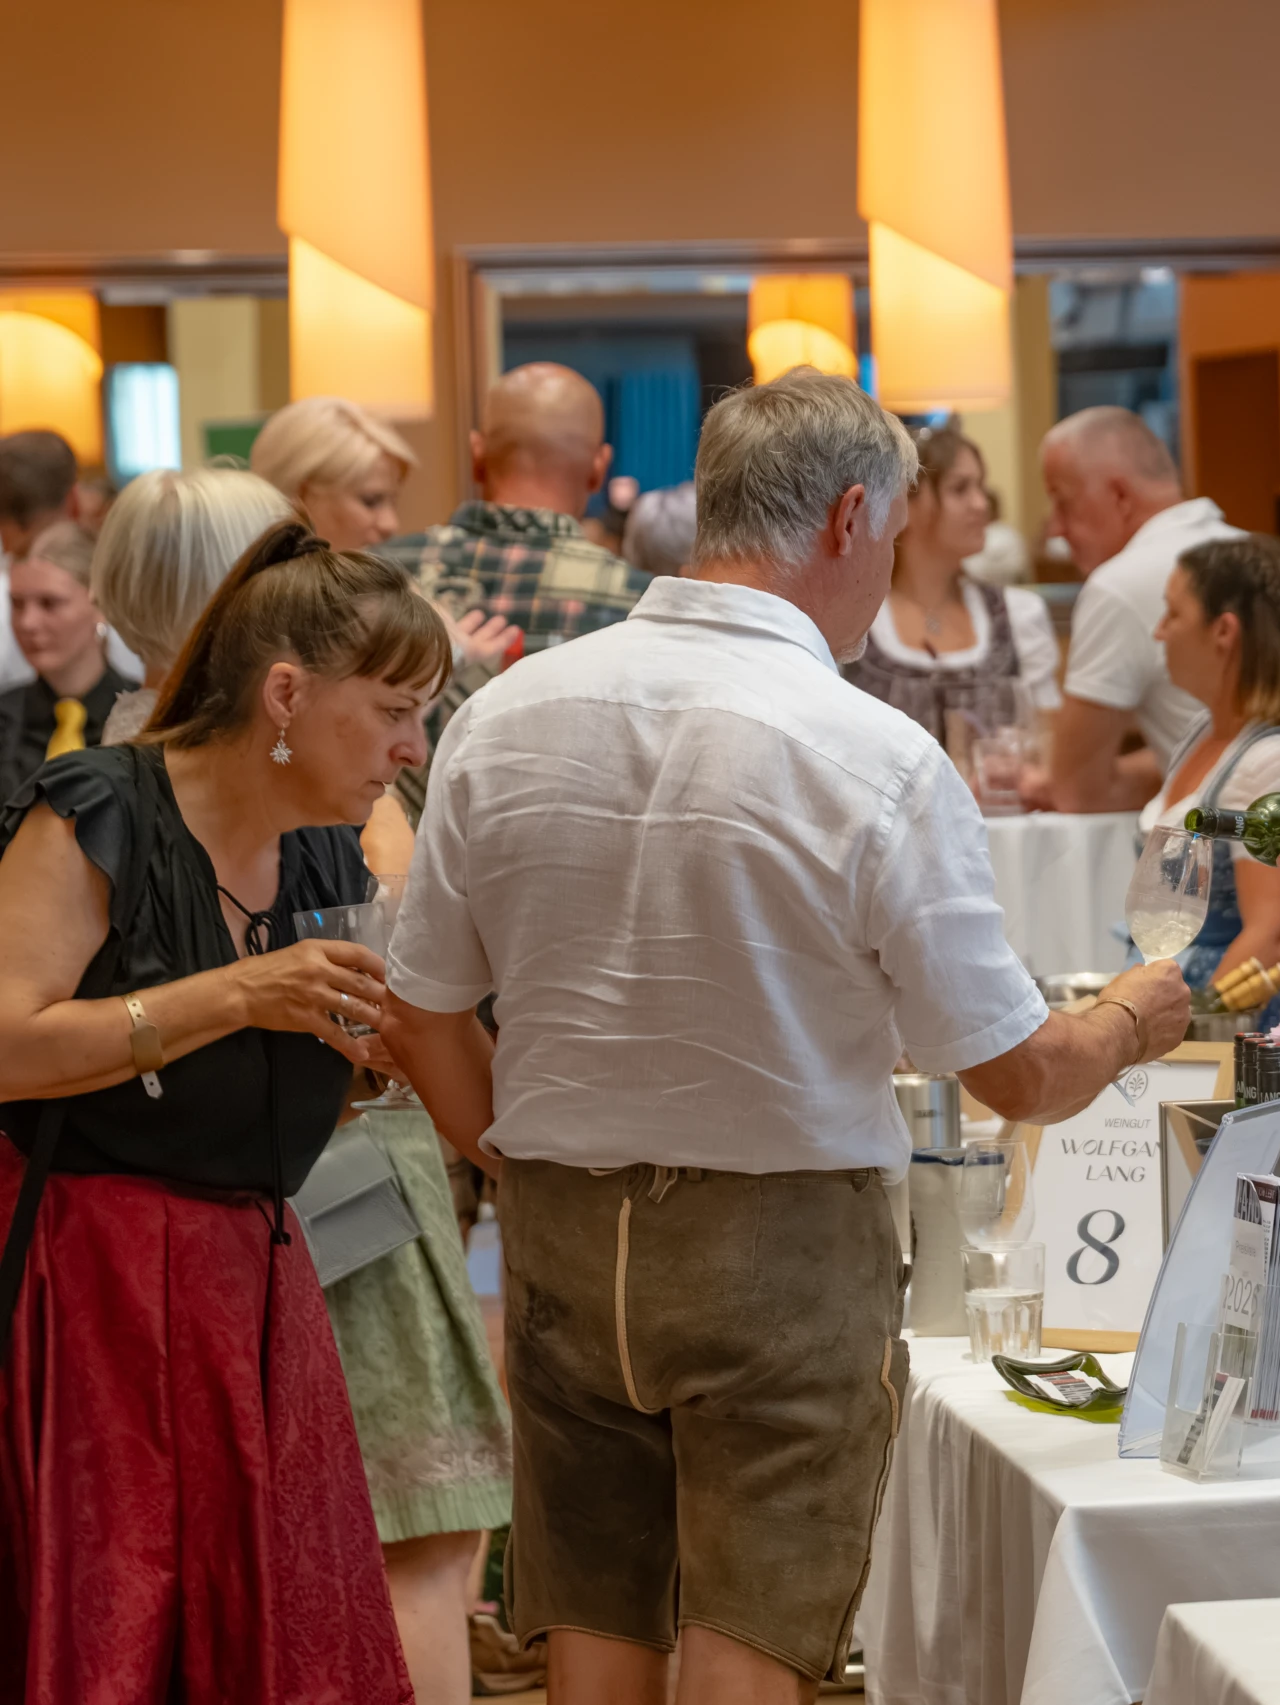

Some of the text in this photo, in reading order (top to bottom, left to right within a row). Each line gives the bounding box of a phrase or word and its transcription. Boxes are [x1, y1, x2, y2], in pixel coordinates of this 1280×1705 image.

[1232, 815, 1245, 839] LANG
[1104, 1117, 1152, 1129] WEINGUT
[1086, 1164, 1146, 1183] LANG
[1066, 1209, 1126, 1286] 8
